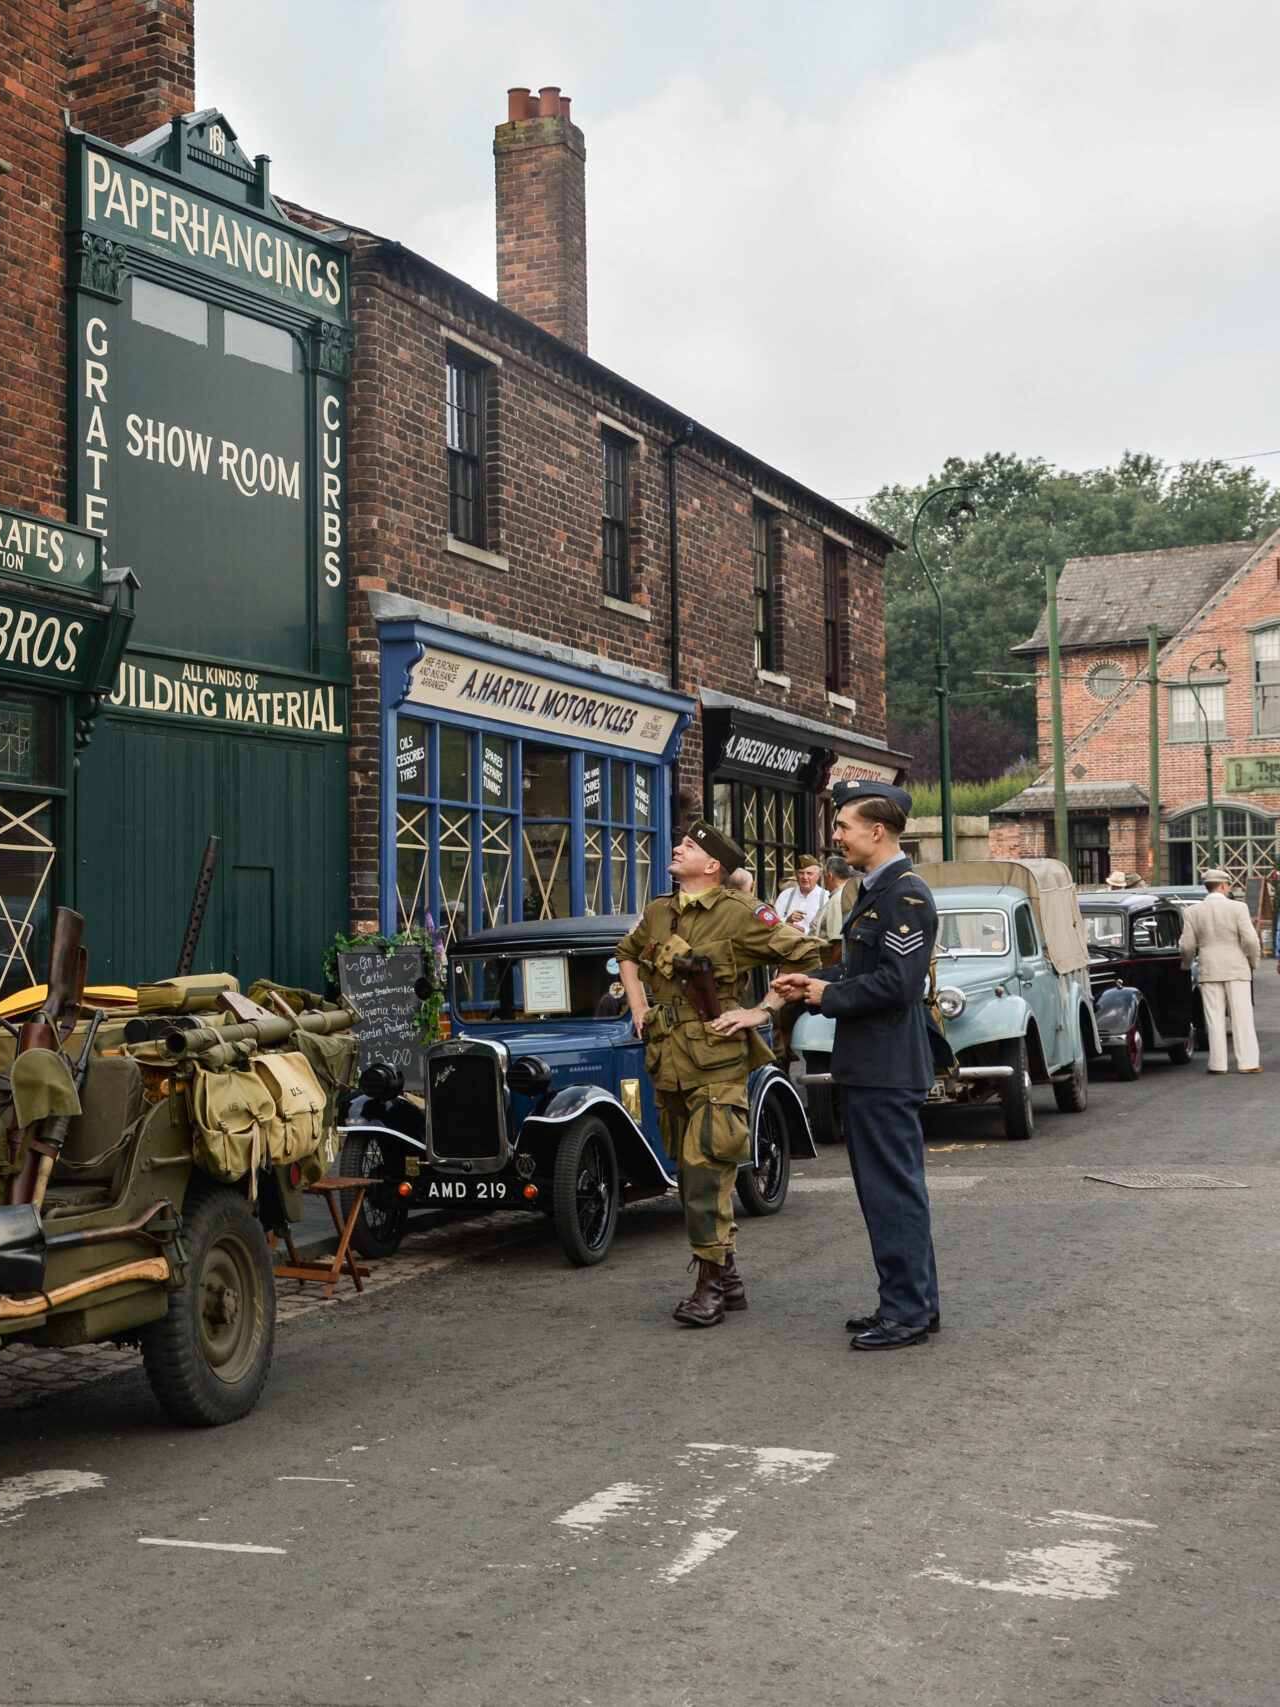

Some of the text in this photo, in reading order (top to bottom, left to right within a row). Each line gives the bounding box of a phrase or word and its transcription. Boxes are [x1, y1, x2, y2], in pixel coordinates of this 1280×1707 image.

[87, 150, 341, 305] PAPERHANGINGS
[85, 317, 109, 569] GRATE
[126, 413, 300, 500] SHOW ROOM
[323, 395, 342, 588] CURBS
[182, 663, 259, 690] ALL KINDS OF
[101, 661, 343, 734] UILDING MATERIAL
[540, 688, 639, 734] MOTORCYCLES
[399, 735, 413, 750] OILS
[484, 747, 503, 769] SPARES
[400, 765, 417, 782] TYRES
[482, 761, 503, 783] REPAIRS
[483, 775, 501, 796] TUNING
[359, 954, 389, 973] Gin Bar
[428, 1182, 506, 1198] AMD 219
